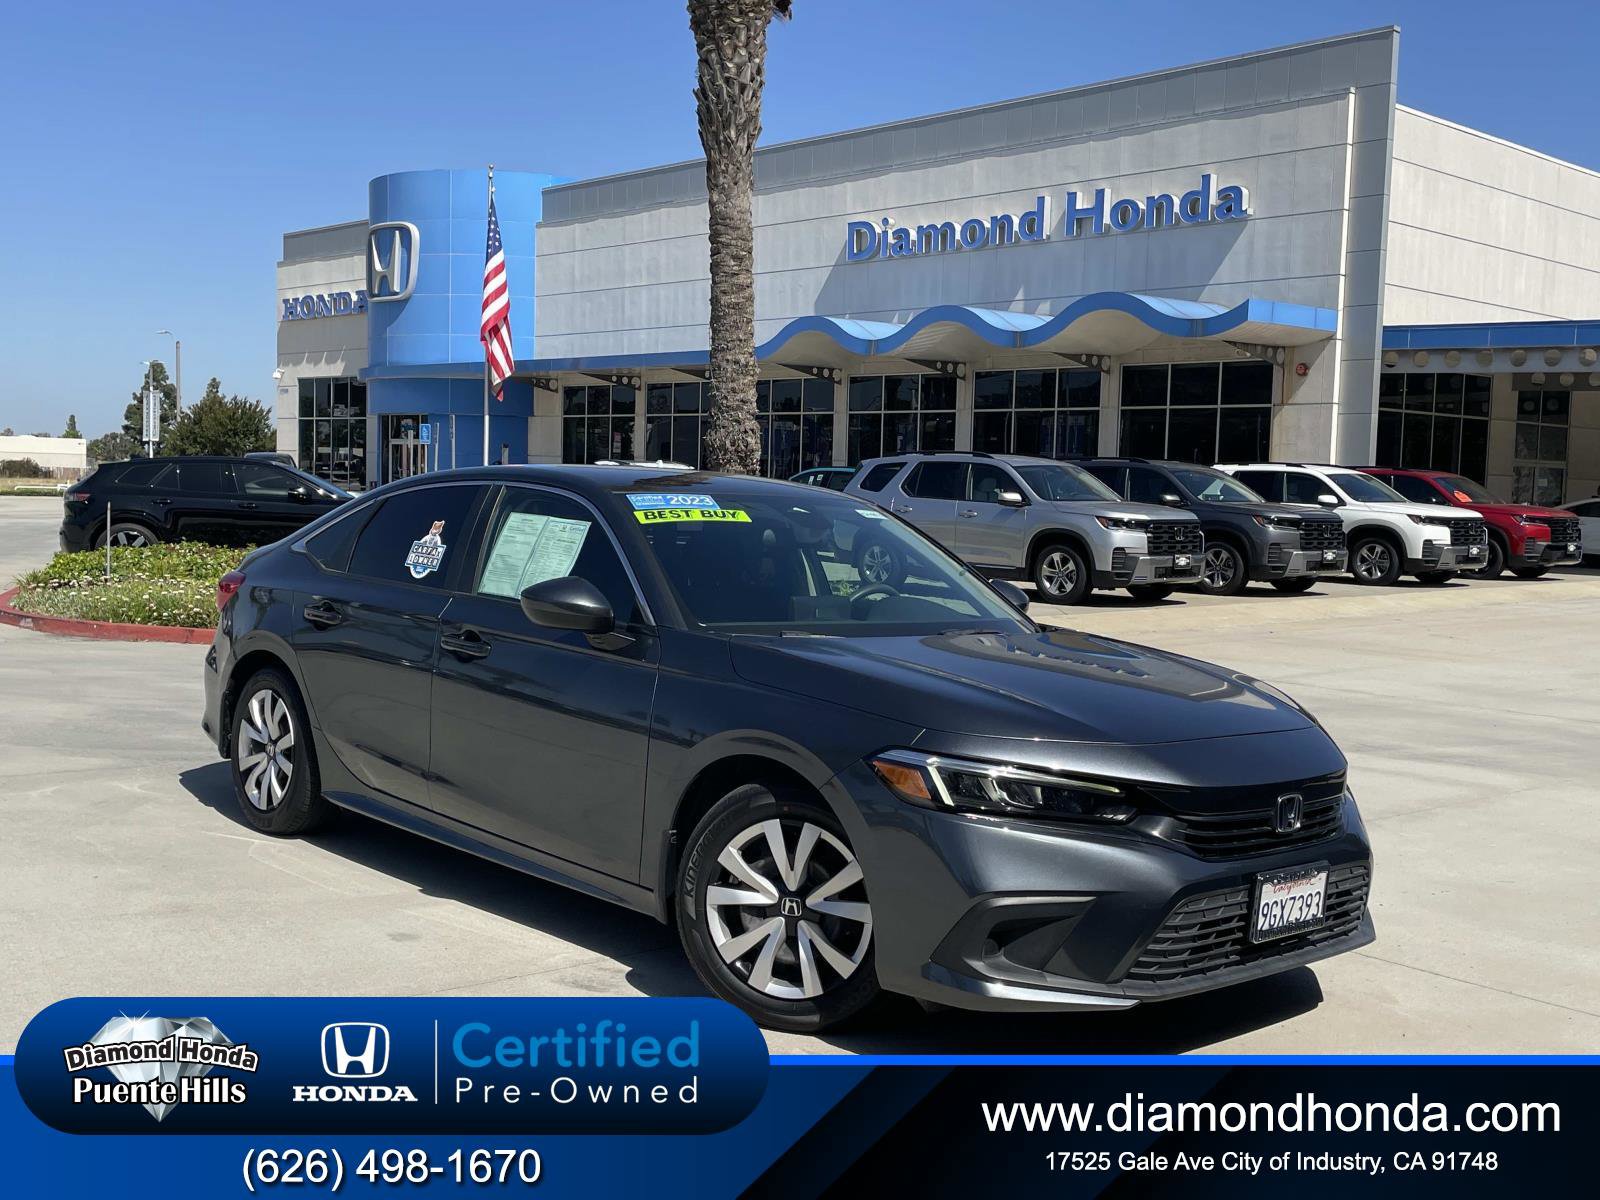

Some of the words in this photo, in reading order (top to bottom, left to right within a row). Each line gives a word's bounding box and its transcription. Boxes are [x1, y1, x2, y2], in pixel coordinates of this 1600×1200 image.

[846, 196, 1051, 262] Diamond
[1065, 173, 1254, 237] Honda
[282, 290, 368, 320] HONDA
[643, 509, 692, 520] BEST
[701, 509, 738, 519] BUY
[667, 496, 714, 506] 2023
[1260, 891, 1321, 931] 9GX7393
